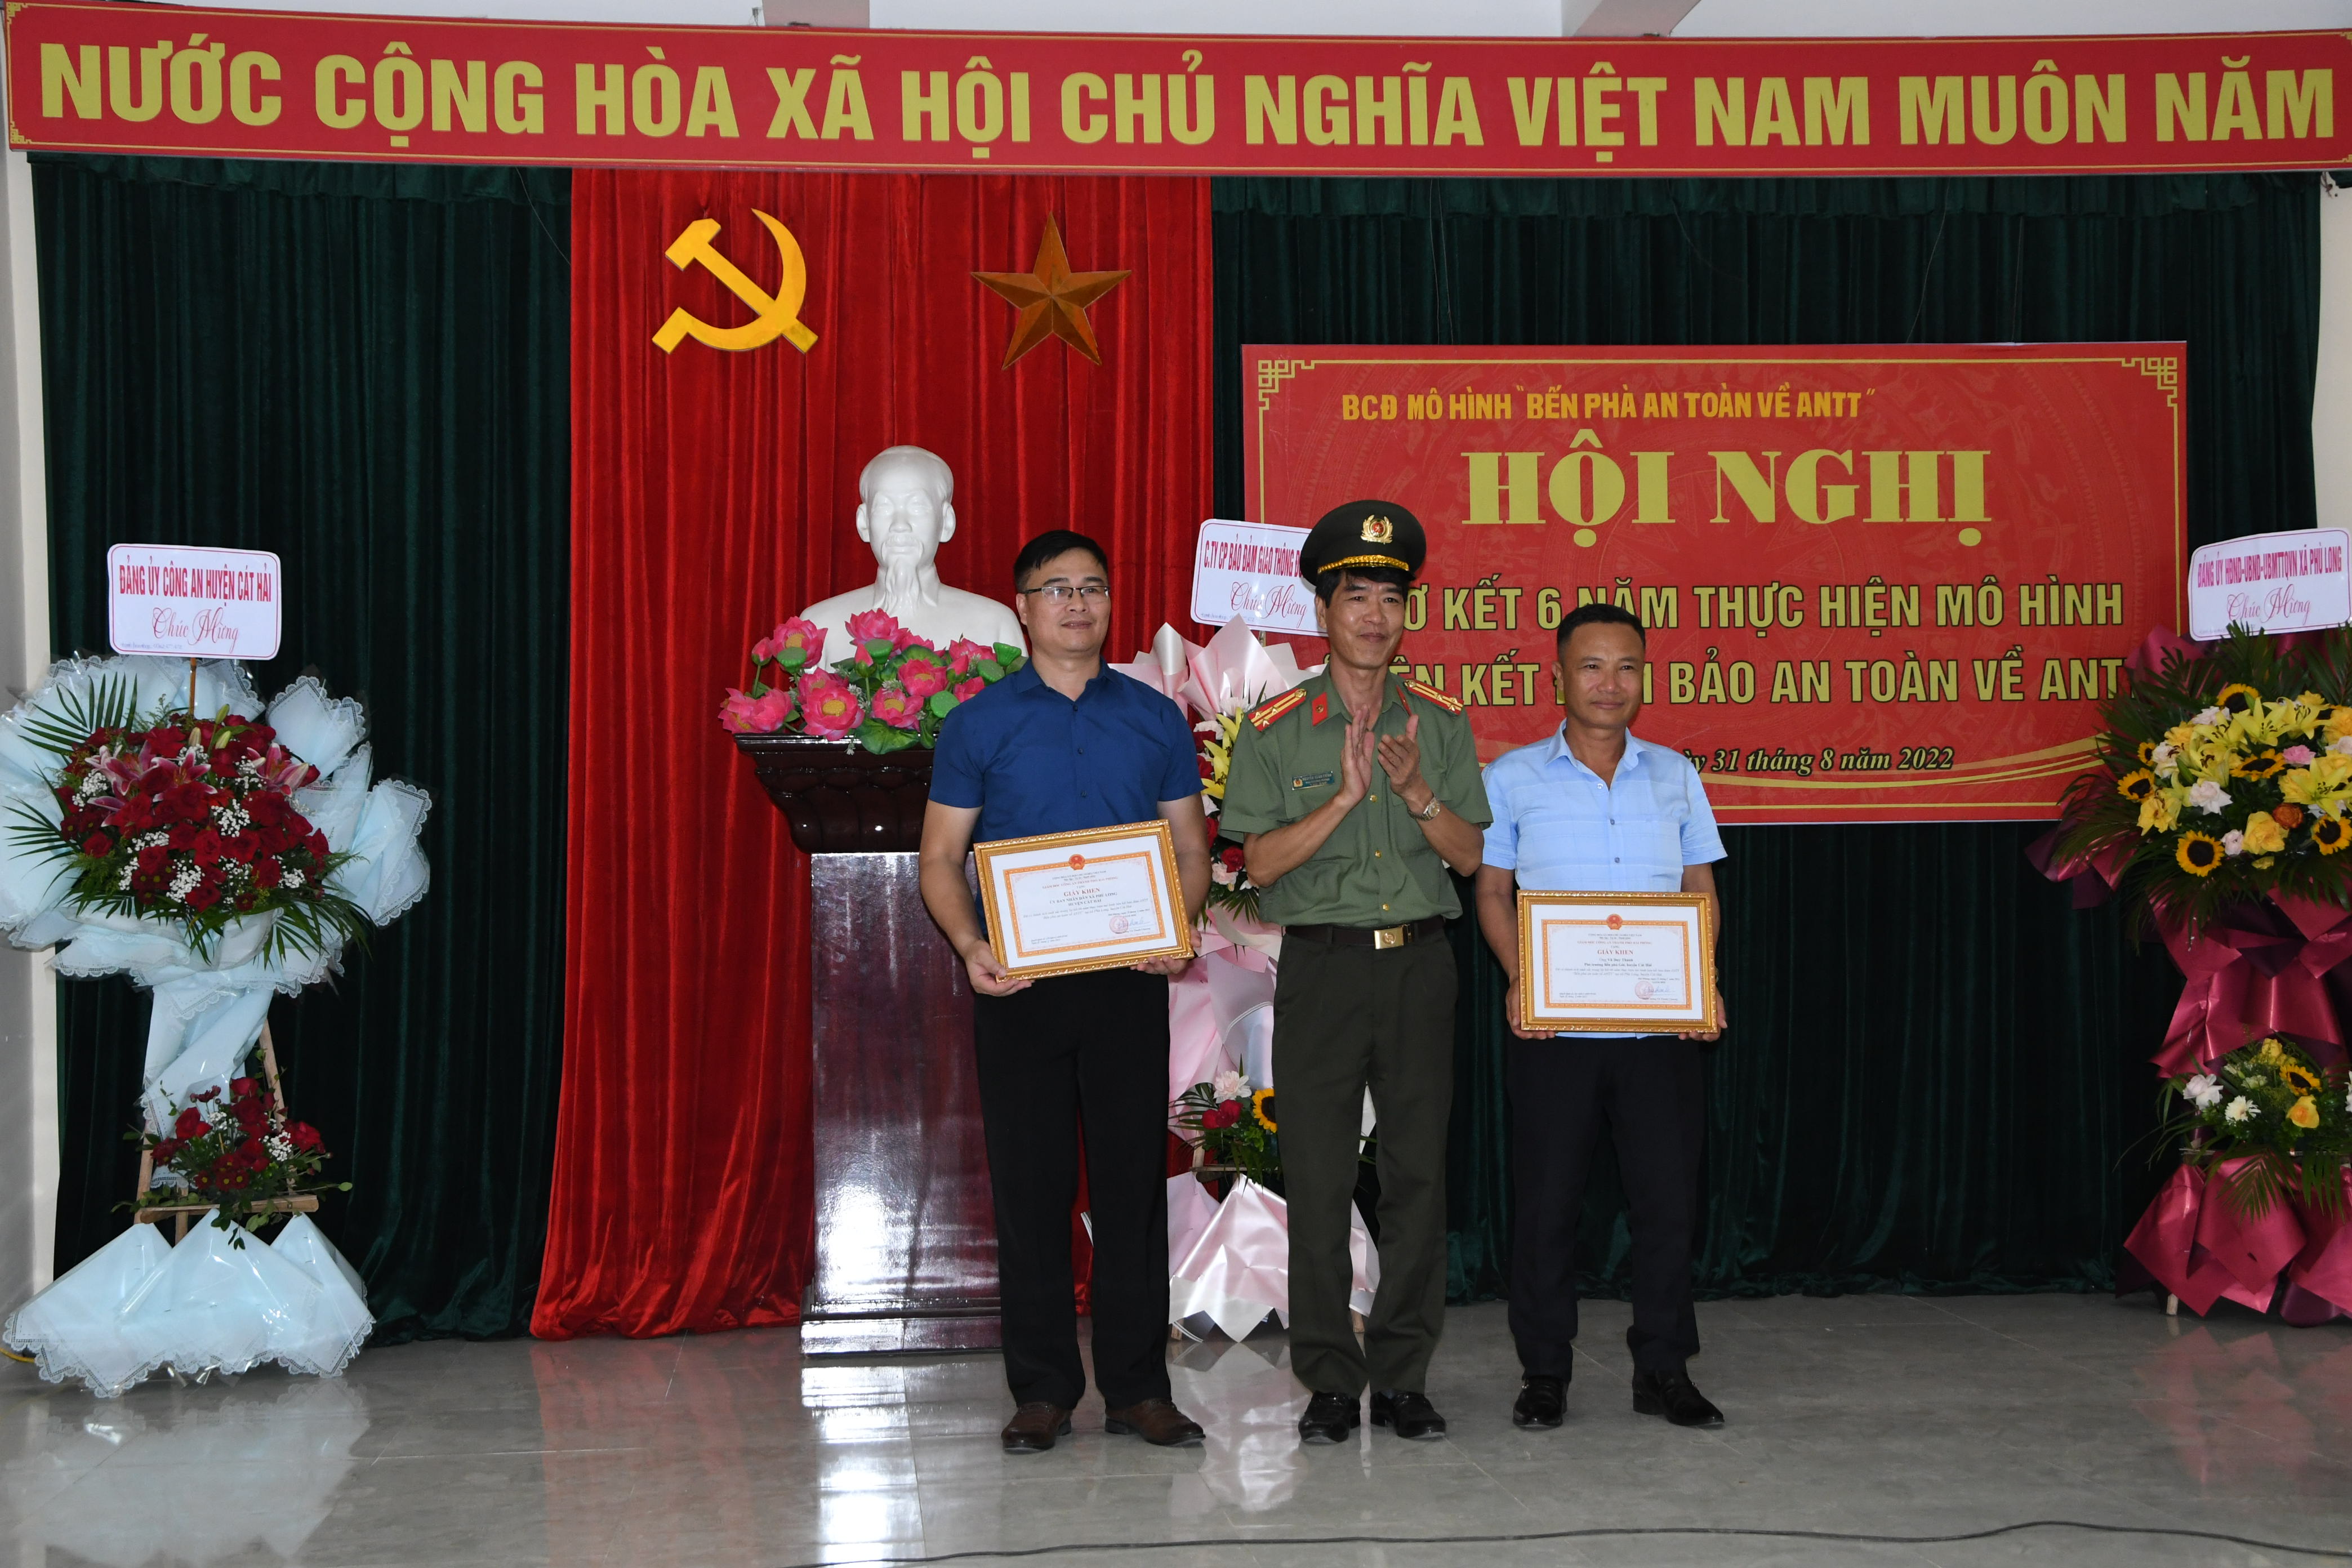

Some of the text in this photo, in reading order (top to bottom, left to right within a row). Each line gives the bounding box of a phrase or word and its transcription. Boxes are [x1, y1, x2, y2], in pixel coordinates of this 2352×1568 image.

[40, 33, 2334, 163] NƯỚC CỘNG HÒA XÃ HỘI CHỦ NGHĨA VIỆT NAM MUÔN NĂM
[1342, 394, 1397, 420] BCĐ
[1407, 387, 1444, 420] MÔ
[1449, 386, 1512, 420] HÌNH
[1584, 384, 1637, 418] PHÀ
[1643, 392, 1678, 418] AN
[1683, 382, 1752, 418] TOÀN
[1757, 382, 1790, 417] VỀ
[1461, 429, 1992, 548] HỘI NGHỊ
[1219, 542, 1228, 570] CP
[1228, 533, 1242, 571] BẢO
[1241, 534, 1258, 573] ĐẢM
[1258, 545, 1273, 574] GIAO
[1273, 542, 1295, 577] THÔNG
[2197, 554, 2215, 588] ĐẢNG
[2298, 544, 2308, 576] XÃ
[2324, 545, 2342, 574] LONG
[119, 554, 272, 607] ĐẢNG ỦY CÔNG AN HUYỆN CÁT HẢI
[1260, 584, 1307, 629] Mừng
[1444, 573, 1522, 631] KẾT
[1538, 587, 1562, 630] 6
[1693, 581, 1803, 638] THỰC
[1820, 576, 1919, 637] HIỆN
[1936, 576, 2003, 626] MÔ
[2020, 574, 2122, 626] HÌNH
[2227, 583, 2311, 626] Chúc Mừng
[152, 607, 239, 654] Chúc Mừng
[1462, 649, 1540, 706] KẾT
[1670, 647, 1755, 703] BẢO
[1771, 661, 1830, 703] AN
[1845, 651, 1958, 702] TOÀN
[1973, 647, 2024, 701] VỀ
[2039, 657, 2135, 701] ANT
[1711, 749, 1739, 772] 31
[1746, 749, 1813, 776] tháng
[1820, 749, 1834, 770] 8
[1840, 749, 1891, 770] năm
[1897, 747, 1954, 769] 2022
